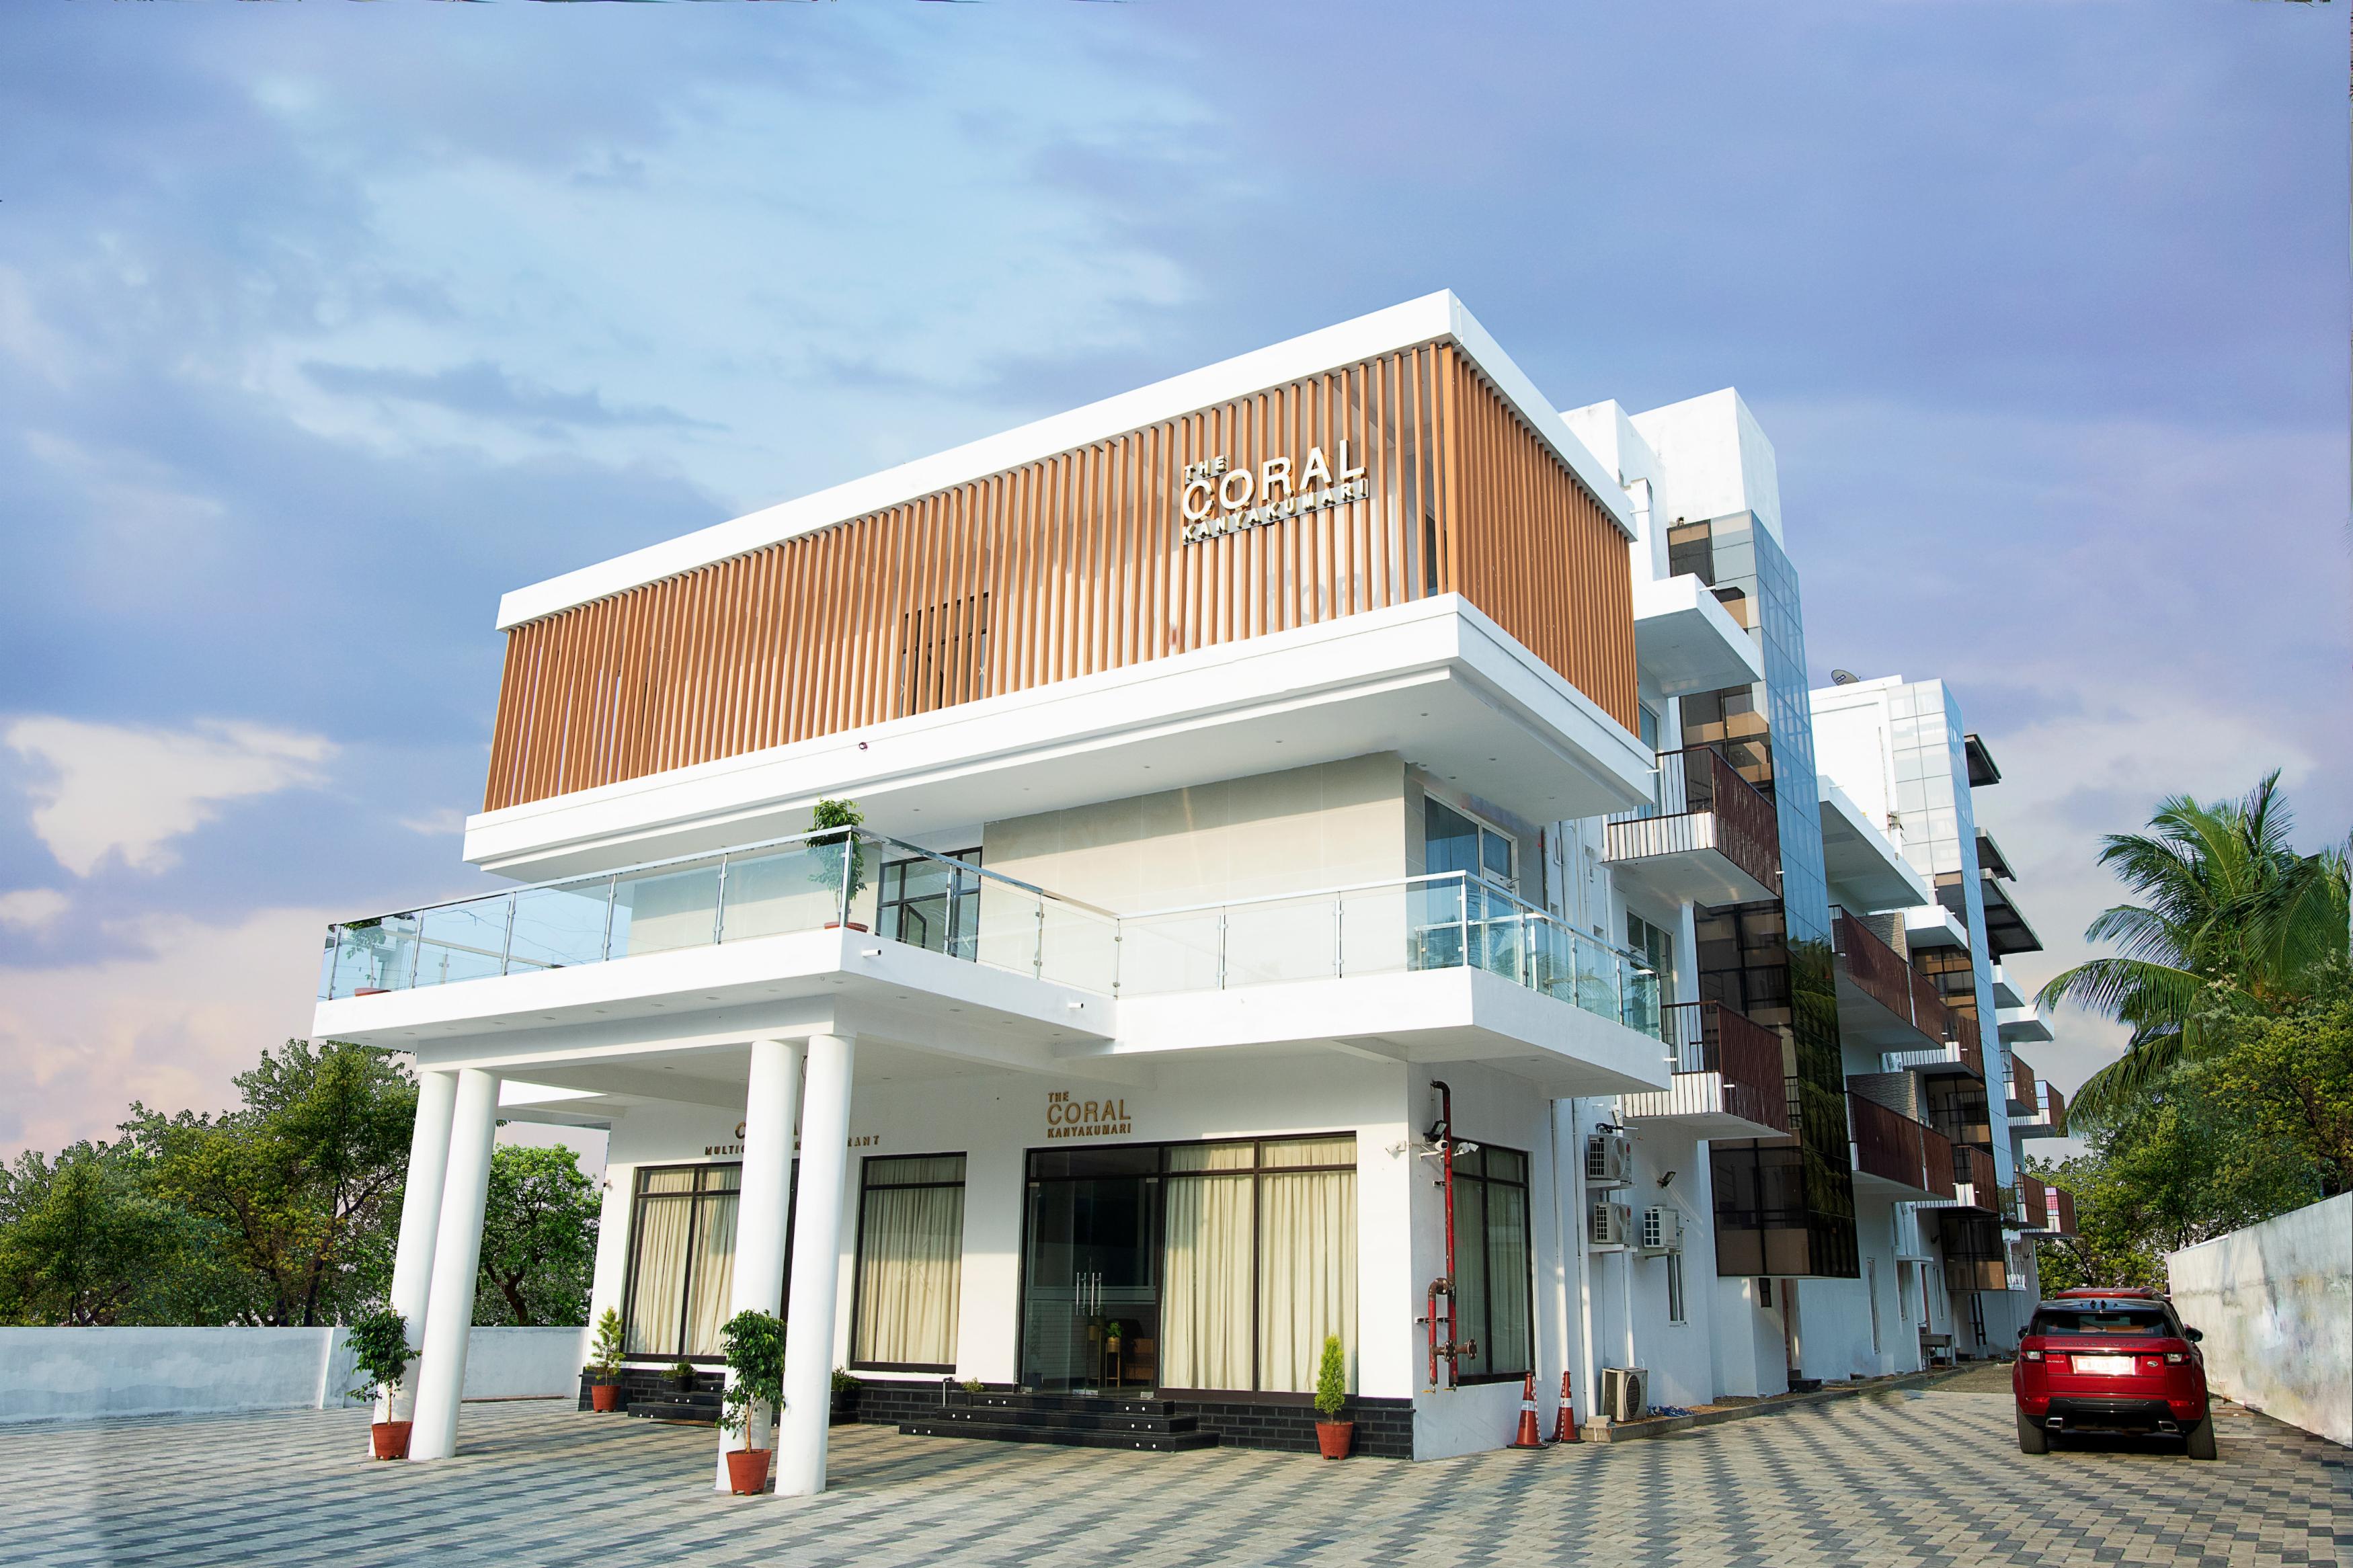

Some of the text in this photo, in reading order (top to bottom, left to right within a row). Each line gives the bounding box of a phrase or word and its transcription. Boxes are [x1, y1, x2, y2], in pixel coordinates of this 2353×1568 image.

[1182, 439, 1367, 522] CORAL
[1184, 455, 1226, 482] THE
[1182, 479, 1367, 542] KANYAKUMARI
[1047, 1091, 1069, 1103] THE
[1047, 1099, 1131, 1125] CORAL
[1047, 1123, 1131, 1139] KANYAKUMARI
